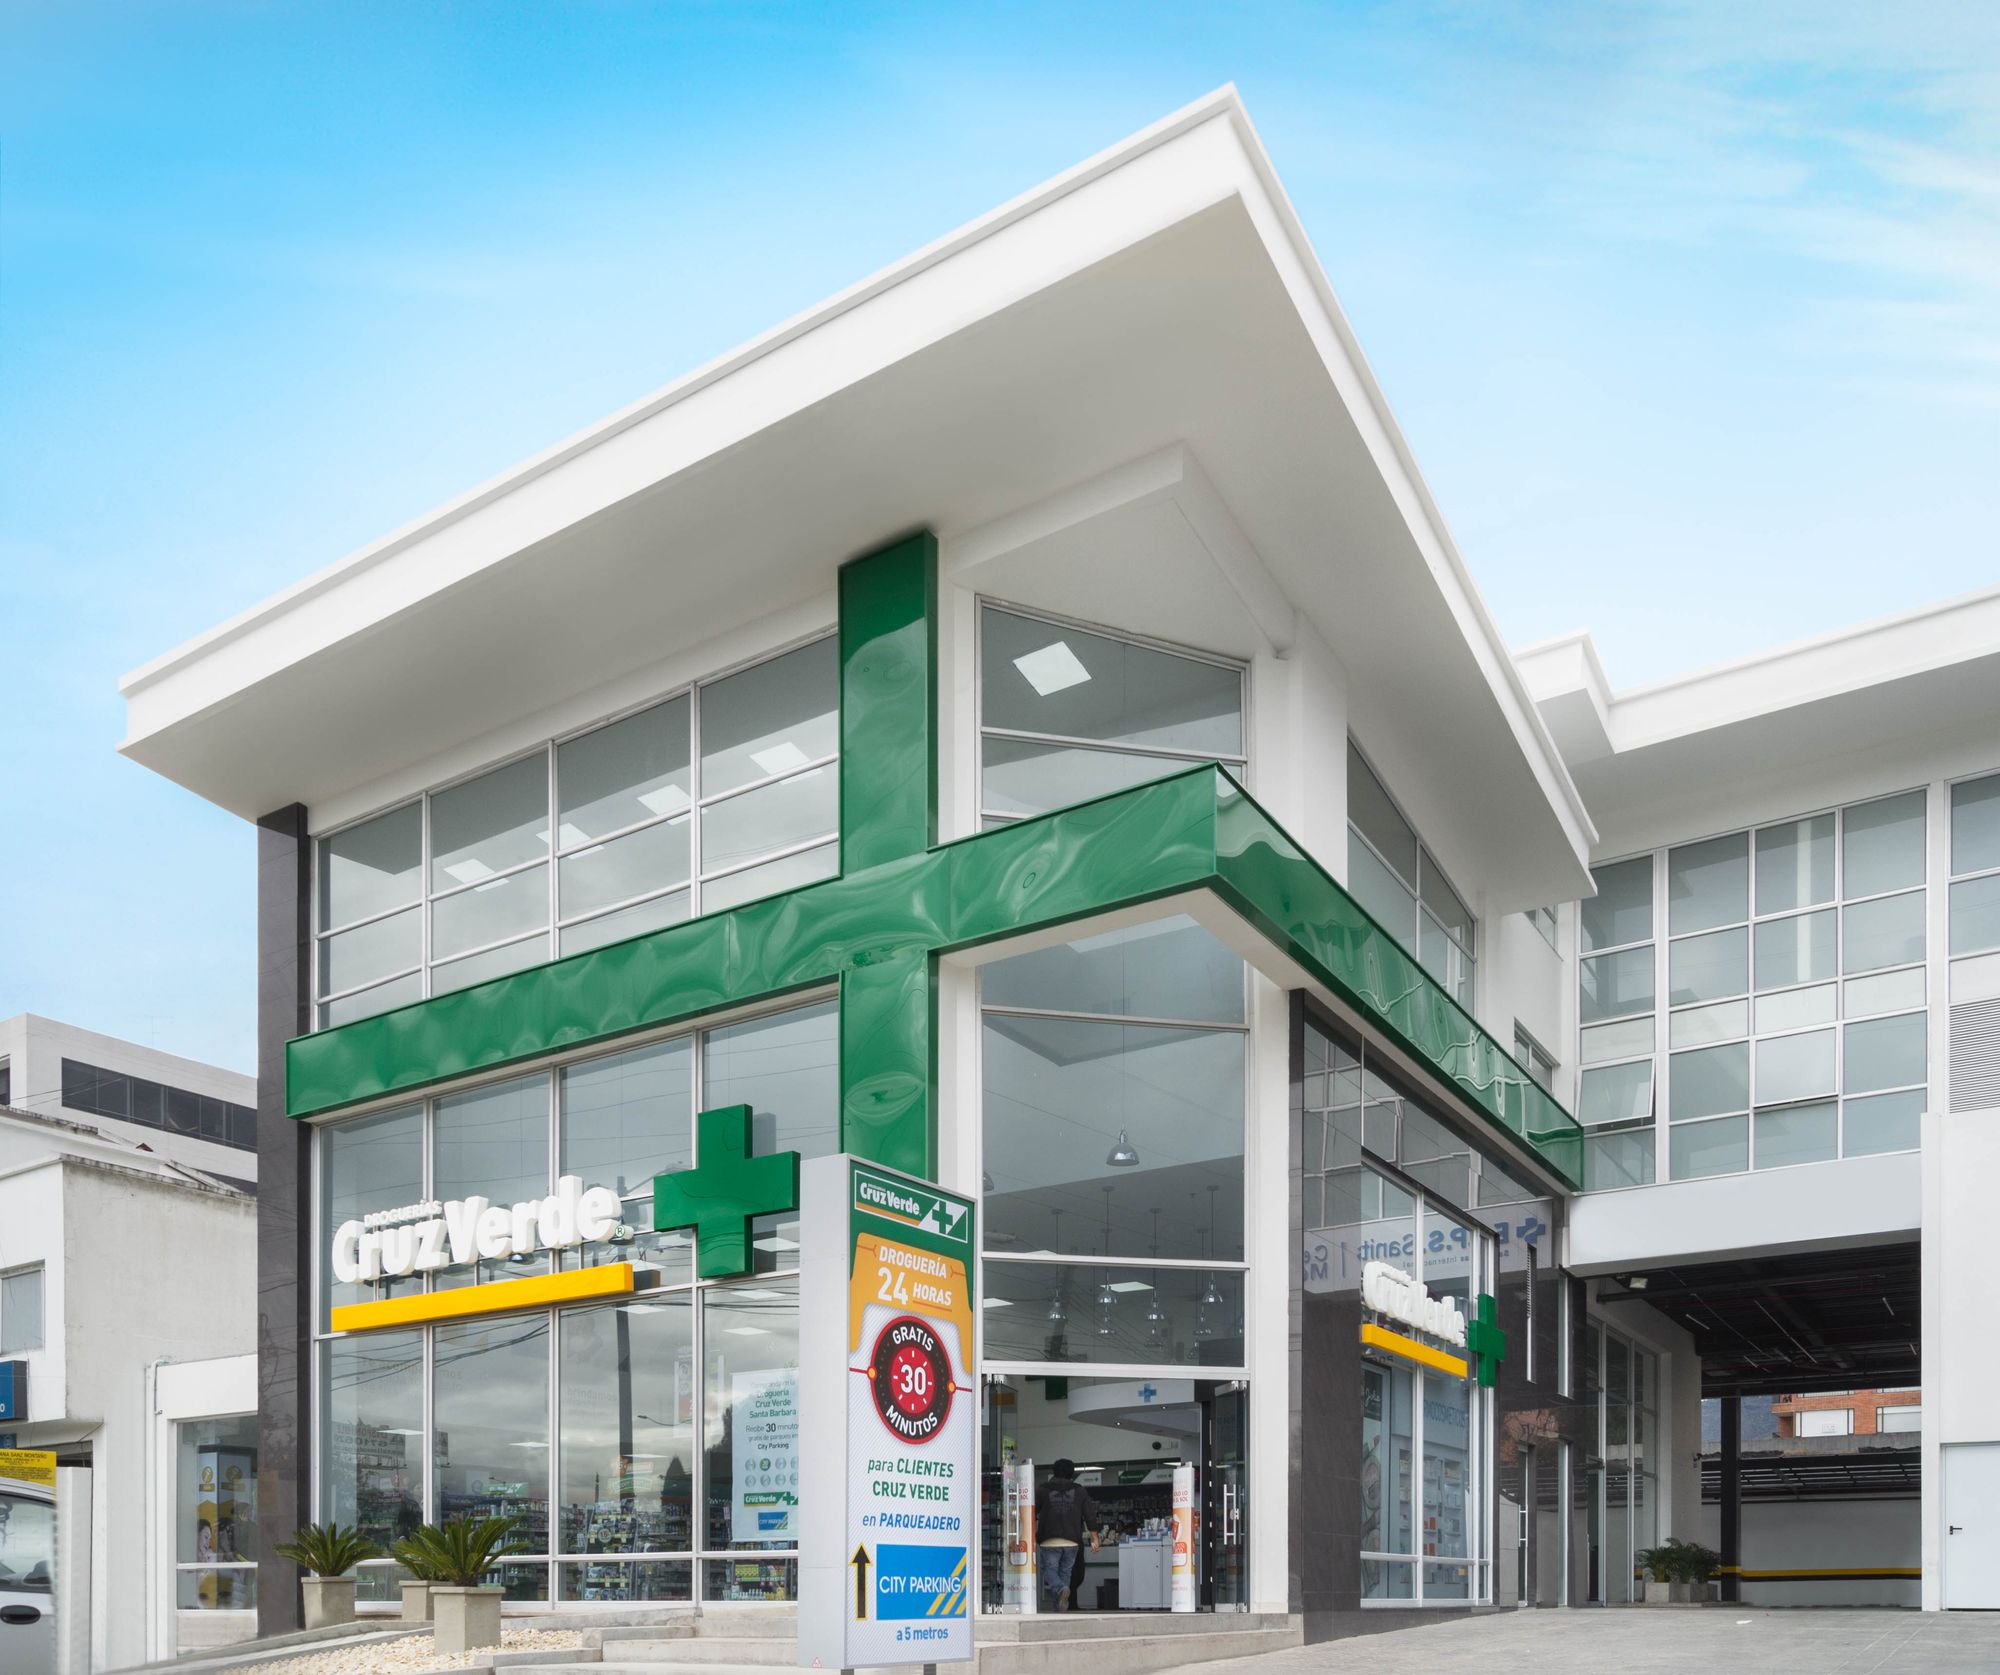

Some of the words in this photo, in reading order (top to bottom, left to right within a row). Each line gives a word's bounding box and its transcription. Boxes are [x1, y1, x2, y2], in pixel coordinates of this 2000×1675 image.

[879, 1246, 948, 1280] DROGUERÍA
[878, 1268, 908, 1305] 24
[913, 1282, 953, 1306] HORAS
[892, 1326, 935, 1352] GRATIS
[900, 1364, 927, 1395] 30
[755, 1400, 771, 1409] Cruz
[771, 1398, 792, 1408] Verde
[749, 1410, 769, 1419] Santa
[769, 1408, 797, 1417] Barbara
[885, 1405, 939, 1437] MINUTOS
[765, 1422, 777, 1433] 30
[777, 1422, 799, 1430] minuto
[757, 1443, 768, 1451] City
[768, 1442, 790, 1450] Parking
[867, 1458, 894, 1473] para
[896, 1458, 954, 1478] CLIENTES
[872, 1481, 907, 1498] CRUZ
[909, 1483, 950, 1502] VERDE
[862, 1515, 876, 1527] en
[878, 1513, 961, 1531] PARQUEADERO
[879, 1576, 905, 1594] CITY
[910, 1576, 962, 1594] PARKING
[896, 1629, 904, 1641] a
[904, 1627, 912, 1641] 5
[913, 1626, 949, 1641] metros
